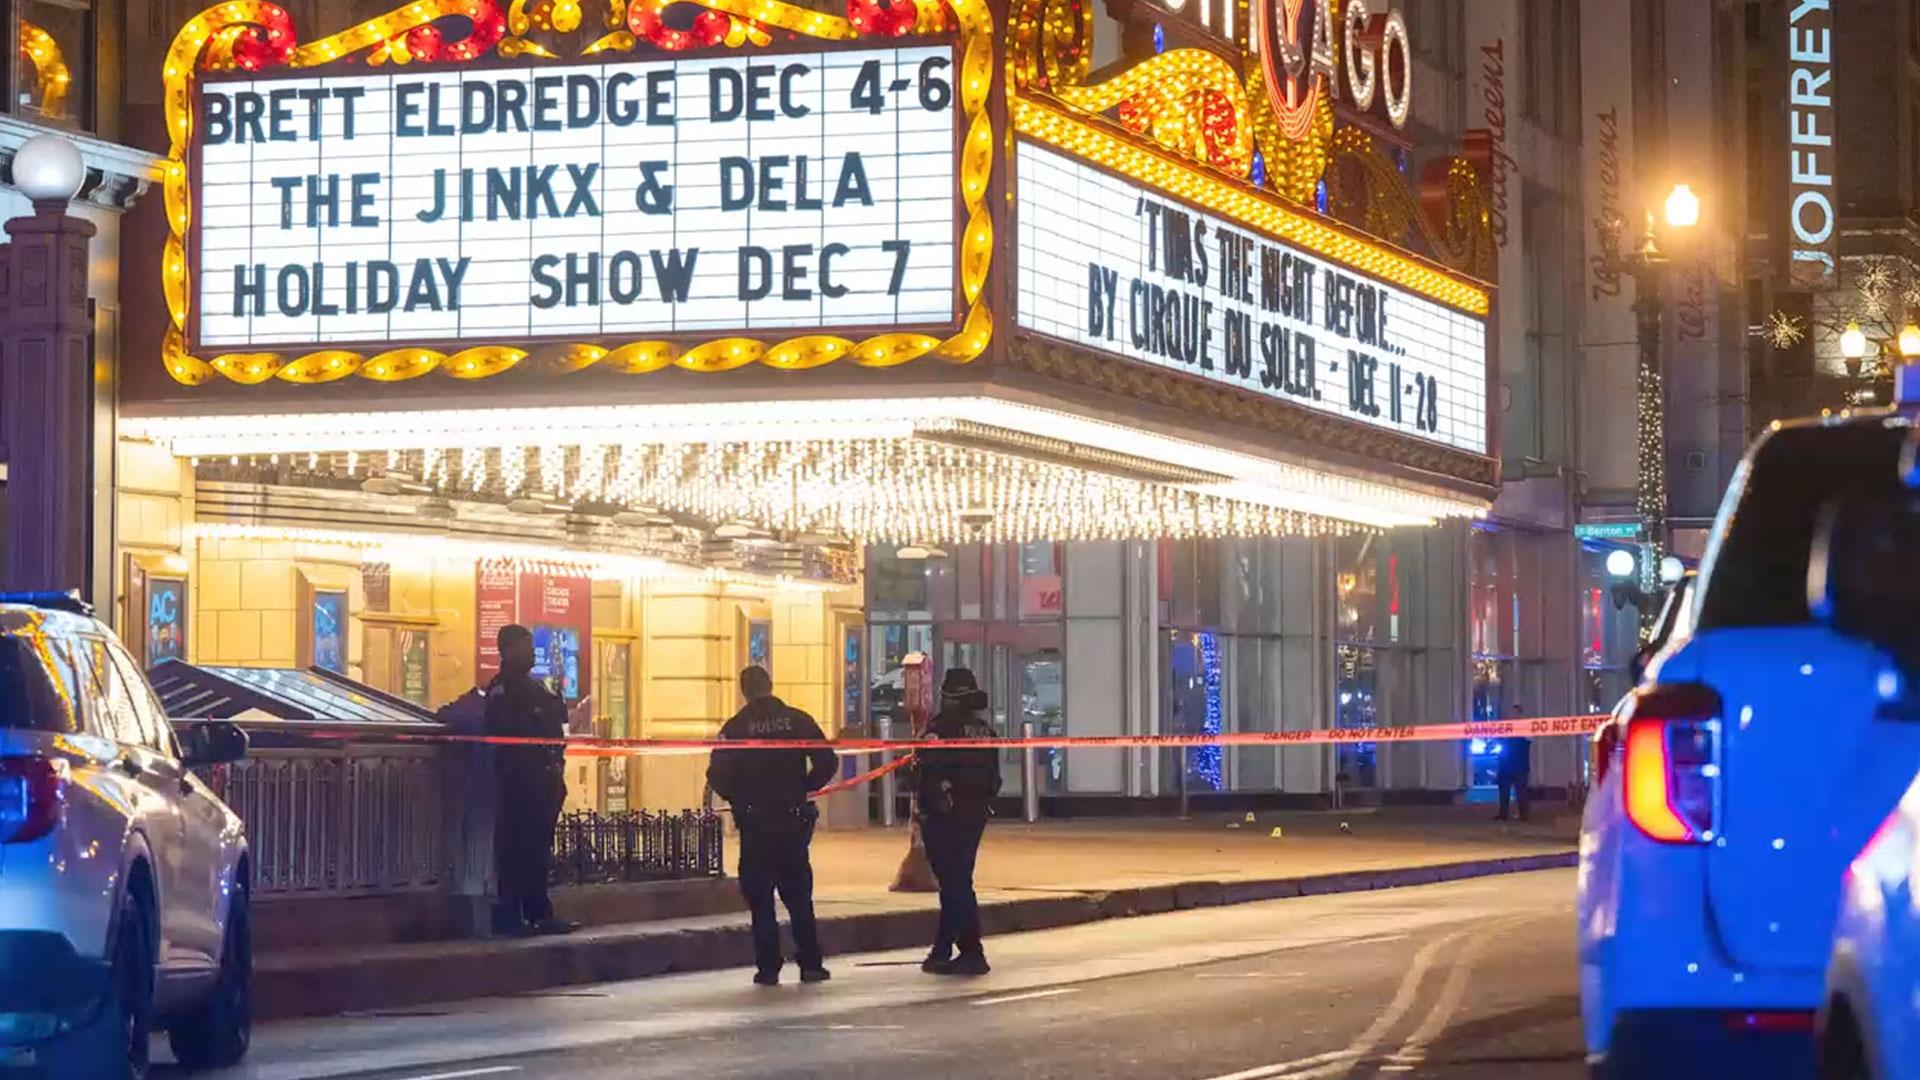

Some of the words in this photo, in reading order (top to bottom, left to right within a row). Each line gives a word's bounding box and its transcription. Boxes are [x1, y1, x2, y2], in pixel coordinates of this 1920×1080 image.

[203, 87, 364, 145] BRETT
[396, 70, 676, 138] ELDREDGE
[709, 63, 811, 123] DEC
[850, 56, 951, 115] 4-6
[1790, 0, 1834, 278] JOFFREY
[271, 172, 380, 230] THE
[416, 162, 600, 224] JINKX
[635, 160, 673, 215] &
[720, 151, 874, 212] DELA
[233, 256, 472, 317] HOLIDAY
[530, 247, 699, 309] SHOW
[738, 242, 850, 301] DEC
[882, 240, 911, 295] 7
[1135, 197, 1208, 287] 'TWAS
[1215, 226, 1254, 305] THE
[1261, 244, 1316, 325] NIGHT
[1324, 268, 1406, 357] BEFORE...
[1088, 262, 1118, 341] BY
[1130, 277, 1214, 371] CIRQUE
[1225, 308, 1251, 379] DU
[1259, 322, 1322, 401] SOLEIL
[1347, 349, 1381, 418] DEC
[748, 718, 792, 737] POLICE
[1263, 730, 1313, 741] DANGER
[1328, 729, 1346, 740] DO
[1348, 728, 1373, 739] NOT
[1376, 726, 1415, 739] ENTER
[1464, 722, 1514, 736] DANGER
[1531, 720, 1548, 733] DO
[1552, 718, 1577, 732] NOT
